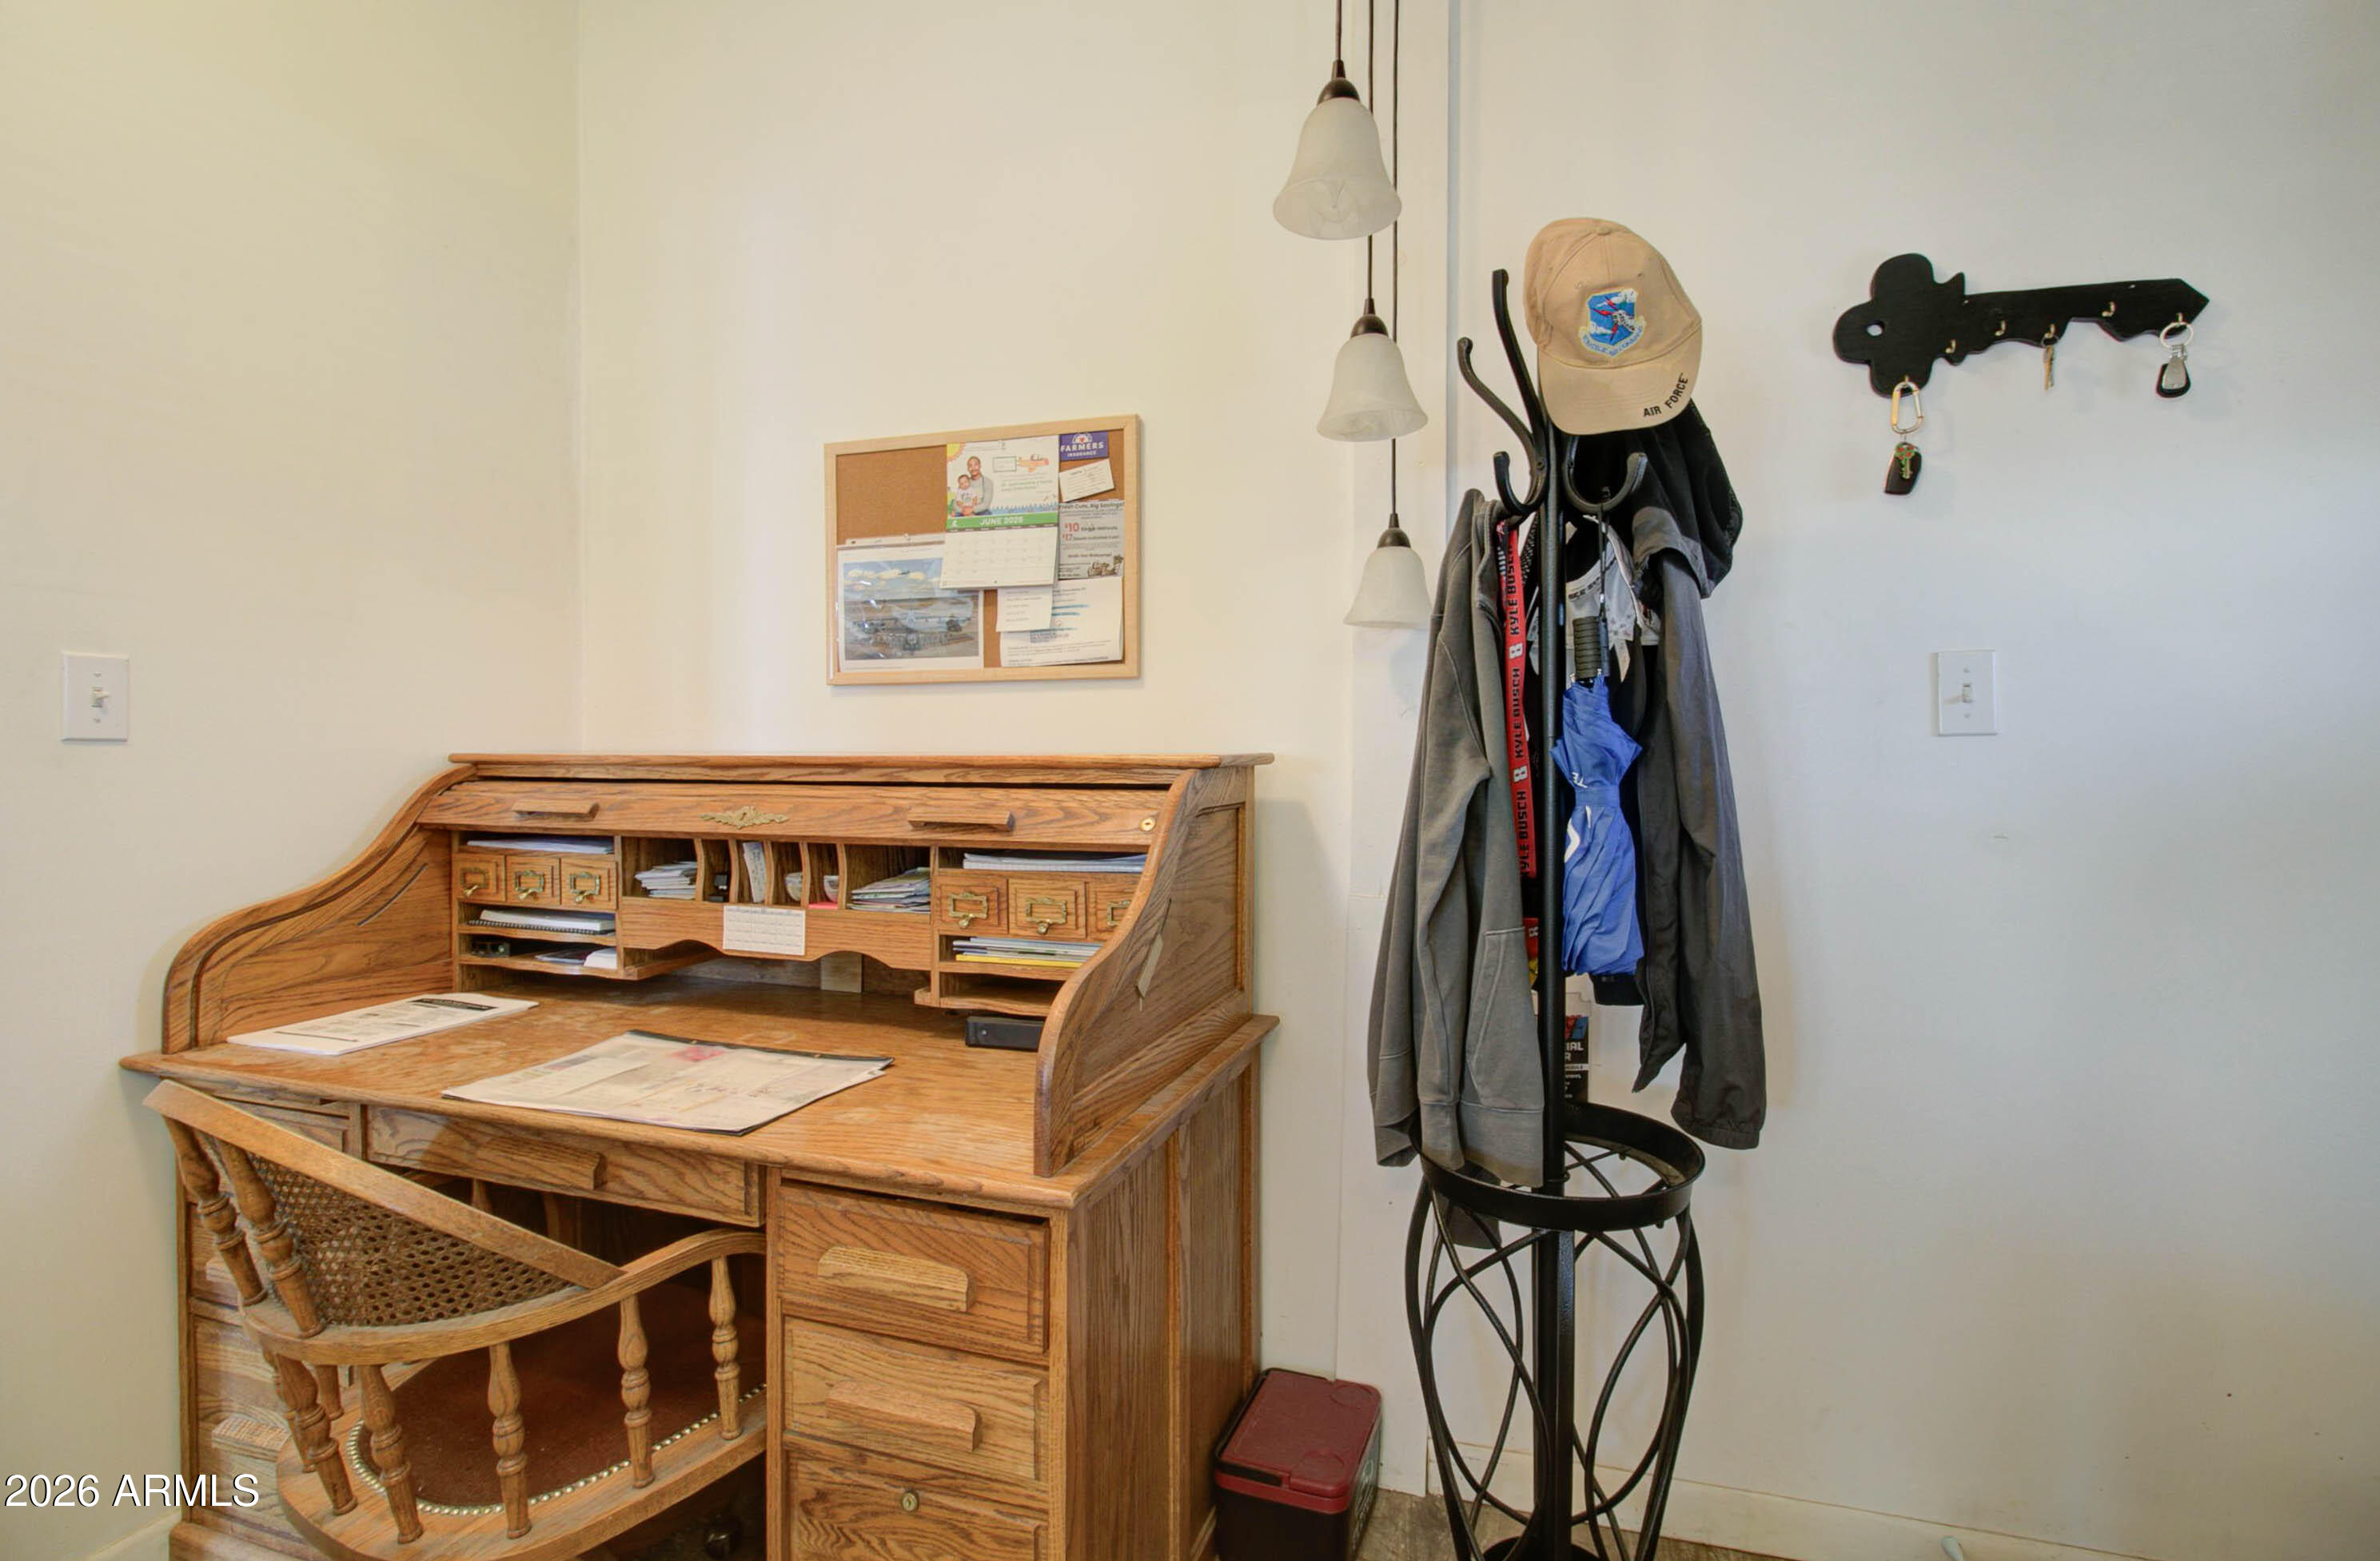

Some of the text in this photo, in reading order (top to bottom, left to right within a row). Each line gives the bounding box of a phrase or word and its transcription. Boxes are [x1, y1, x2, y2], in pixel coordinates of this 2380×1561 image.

[1643, 372, 1688, 417] AIR FORCE
[1060, 441, 1104, 452] FARMERS
[980, 517, 1002, 526] JUNE
[1509, 599, 1520, 635] KYLE
[1508, 643, 1523, 659] 8
[1512, 667, 1521, 717] BUSCH
[1513, 722, 1524, 759] KYLE
[1513, 765, 1528, 782] 8
[1517, 790, 1529, 840] BUSCH
